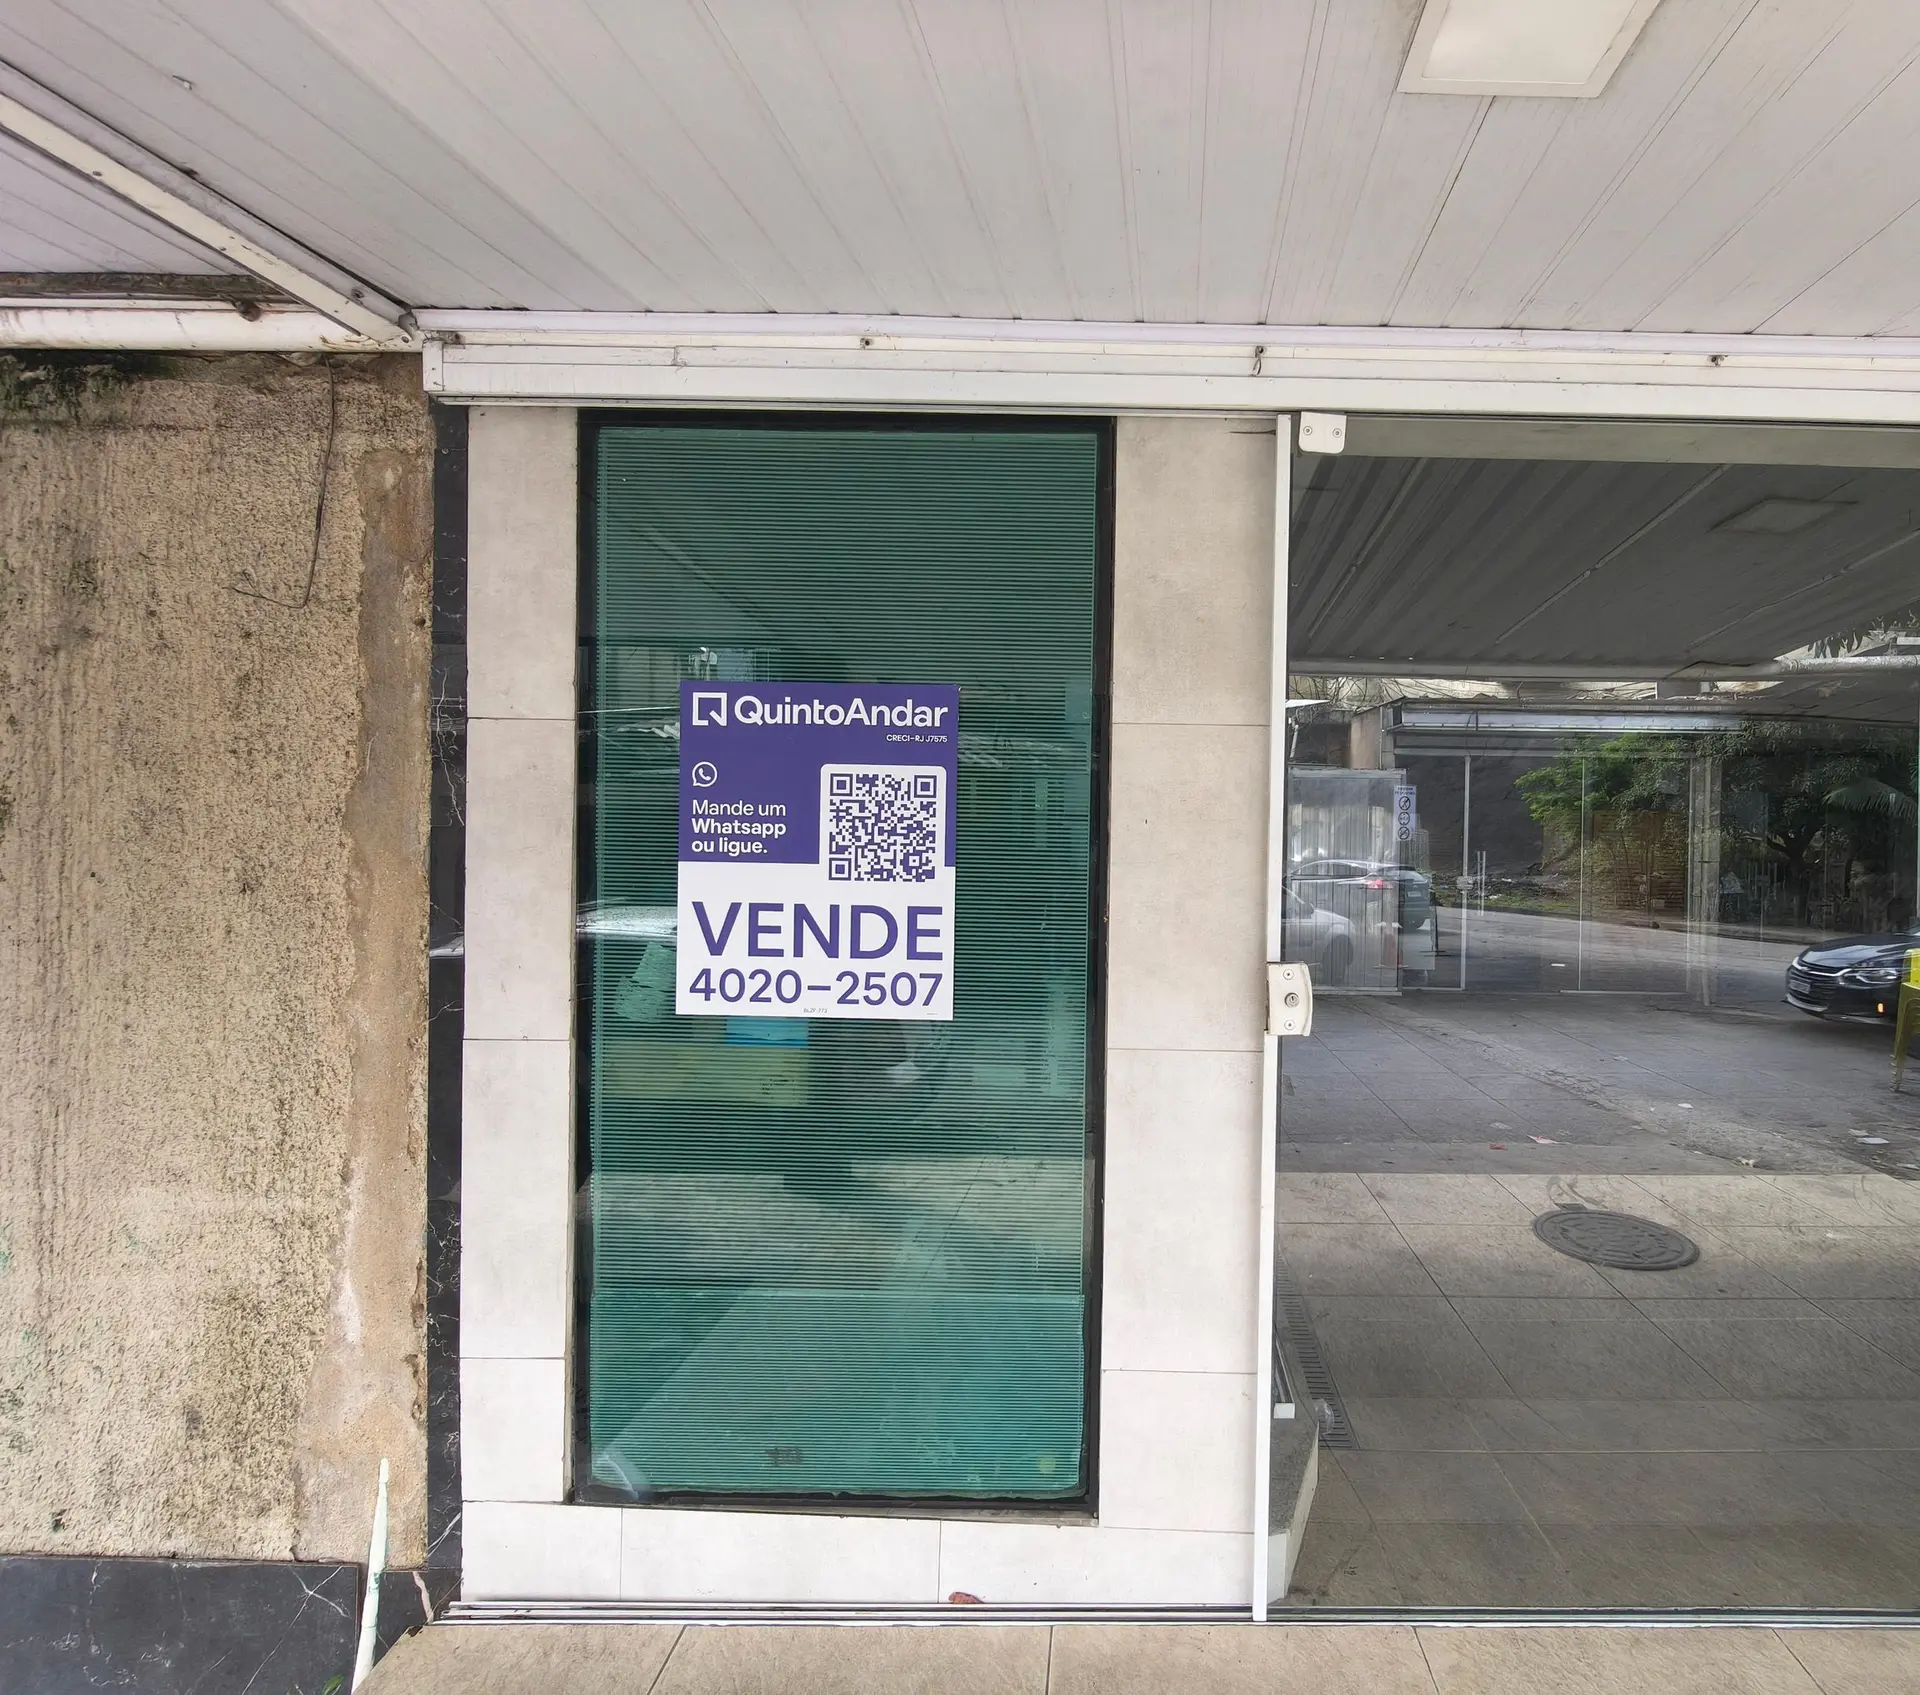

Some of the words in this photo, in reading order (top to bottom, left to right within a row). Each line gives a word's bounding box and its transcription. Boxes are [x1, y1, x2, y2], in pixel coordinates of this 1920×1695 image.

[734, 695, 949, 727] QuintoAndar
[925, 735, 948, 743] J7575
[692, 800, 754, 816] Mande
[758, 803, 786, 816] um
[691, 819, 787, 839] Whatsapp
[691, 840, 714, 853] ou
[719, 839, 768, 857] ligue.
[691, 901, 943, 960] VENDE
[689, 968, 943, 1006] 4020-2507
